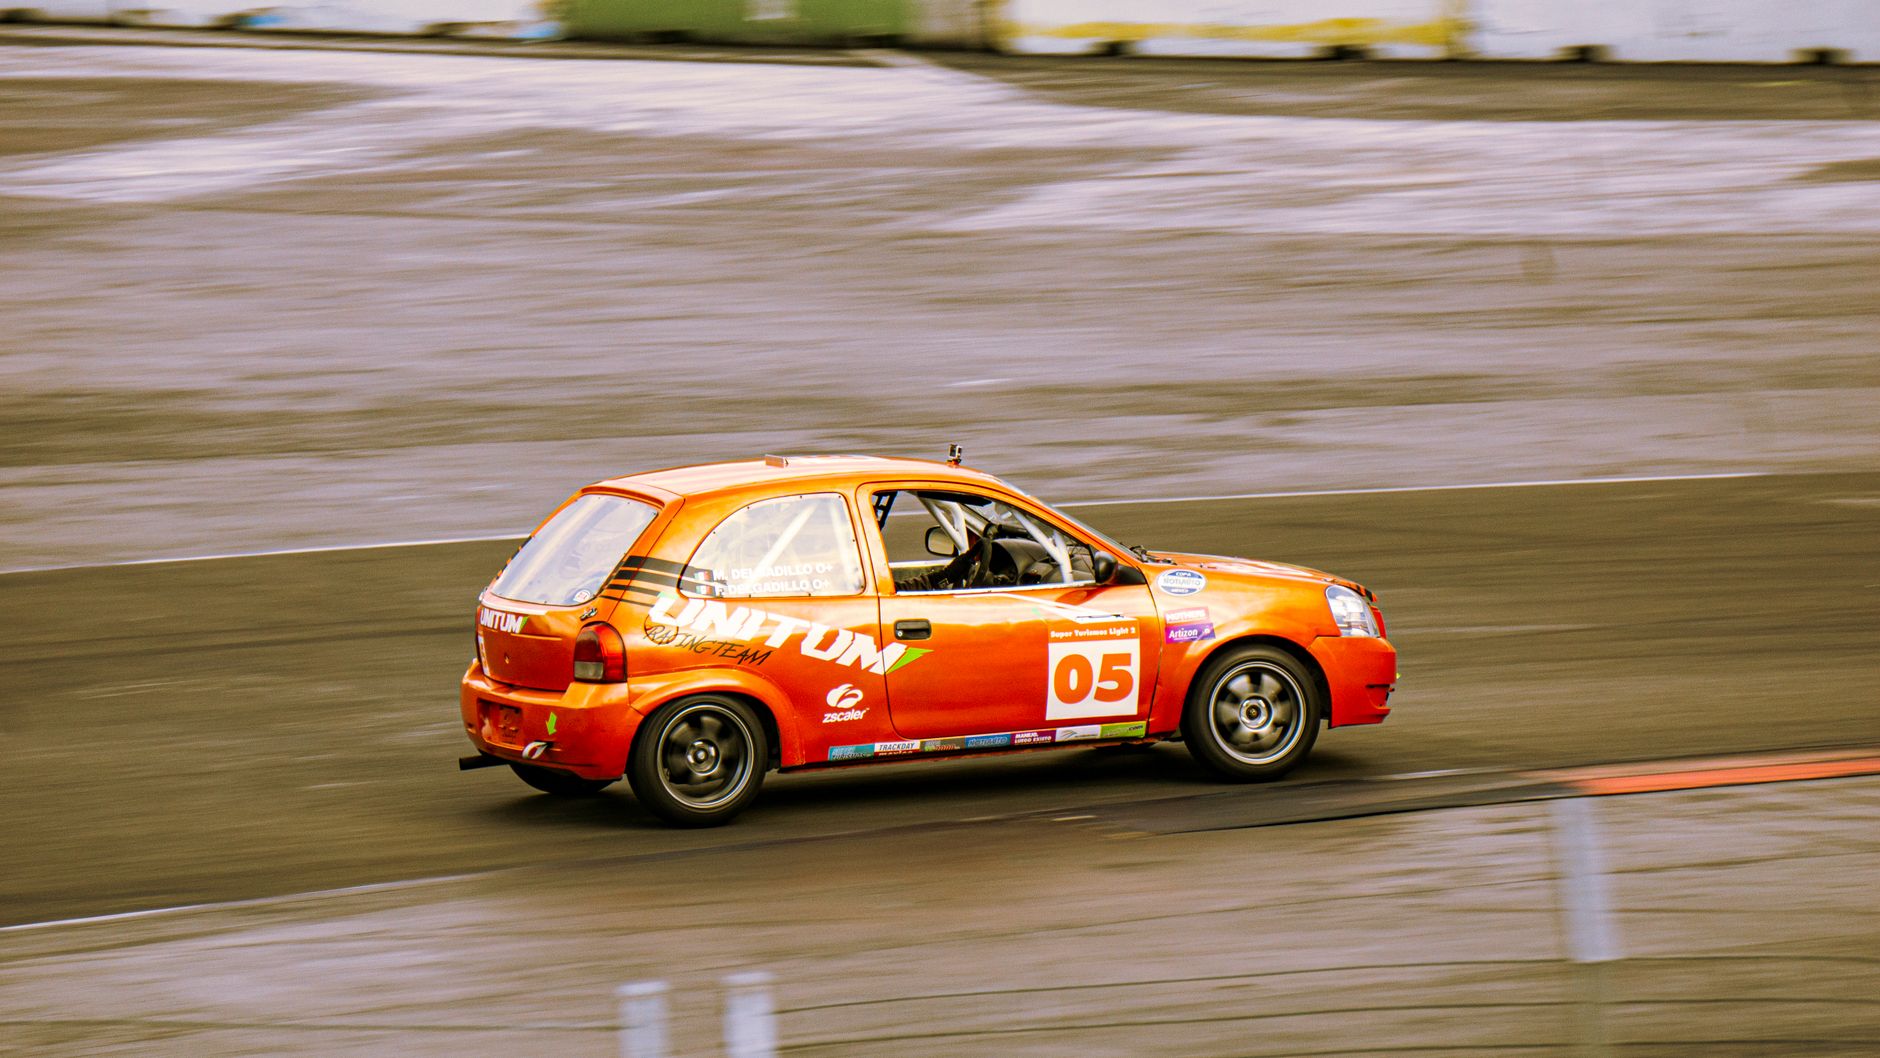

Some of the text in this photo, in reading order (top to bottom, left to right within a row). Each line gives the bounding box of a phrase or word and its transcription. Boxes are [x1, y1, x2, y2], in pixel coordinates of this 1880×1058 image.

[480, 607, 523, 634] UNITUM
[649, 592, 908, 675] UNITUM
[1050, 630, 1072, 639] Super
[1074, 628, 1108, 637] Turismos
[1109, 627, 1129, 636] Light
[1168, 627, 1198, 639] Artizon
[1054, 653, 1134, 704] 05
[822, 708, 867, 723] zscaler
[879, 742, 915, 751] TRACKDAY
